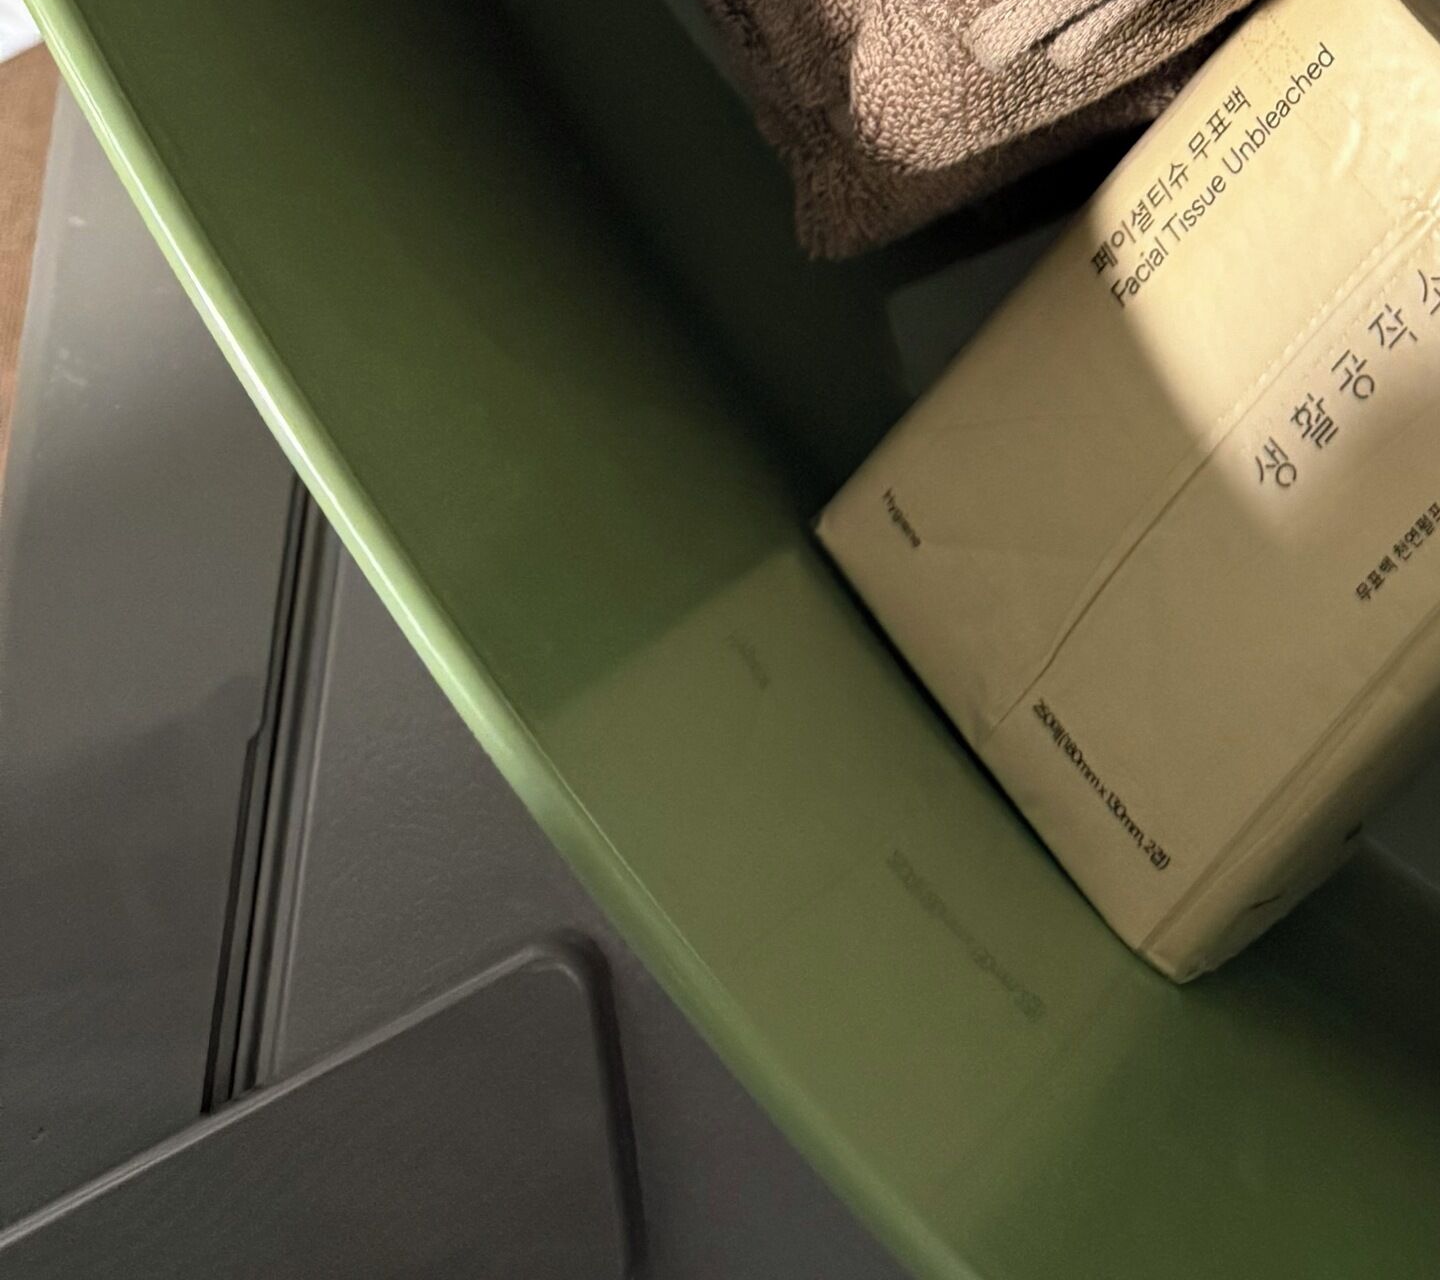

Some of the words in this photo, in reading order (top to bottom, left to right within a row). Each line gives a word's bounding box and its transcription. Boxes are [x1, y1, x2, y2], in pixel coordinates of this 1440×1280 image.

[1089, 159, 1189, 274] 페이셜티슈
[1185, 84, 1251, 159] 무표백
[1109, 236, 1170, 309] Facial
[1161, 175, 1228, 244] Tissue
[1221, 41, 1336, 176] Unbleached
[1354, 554, 1398, 601] 무표백
